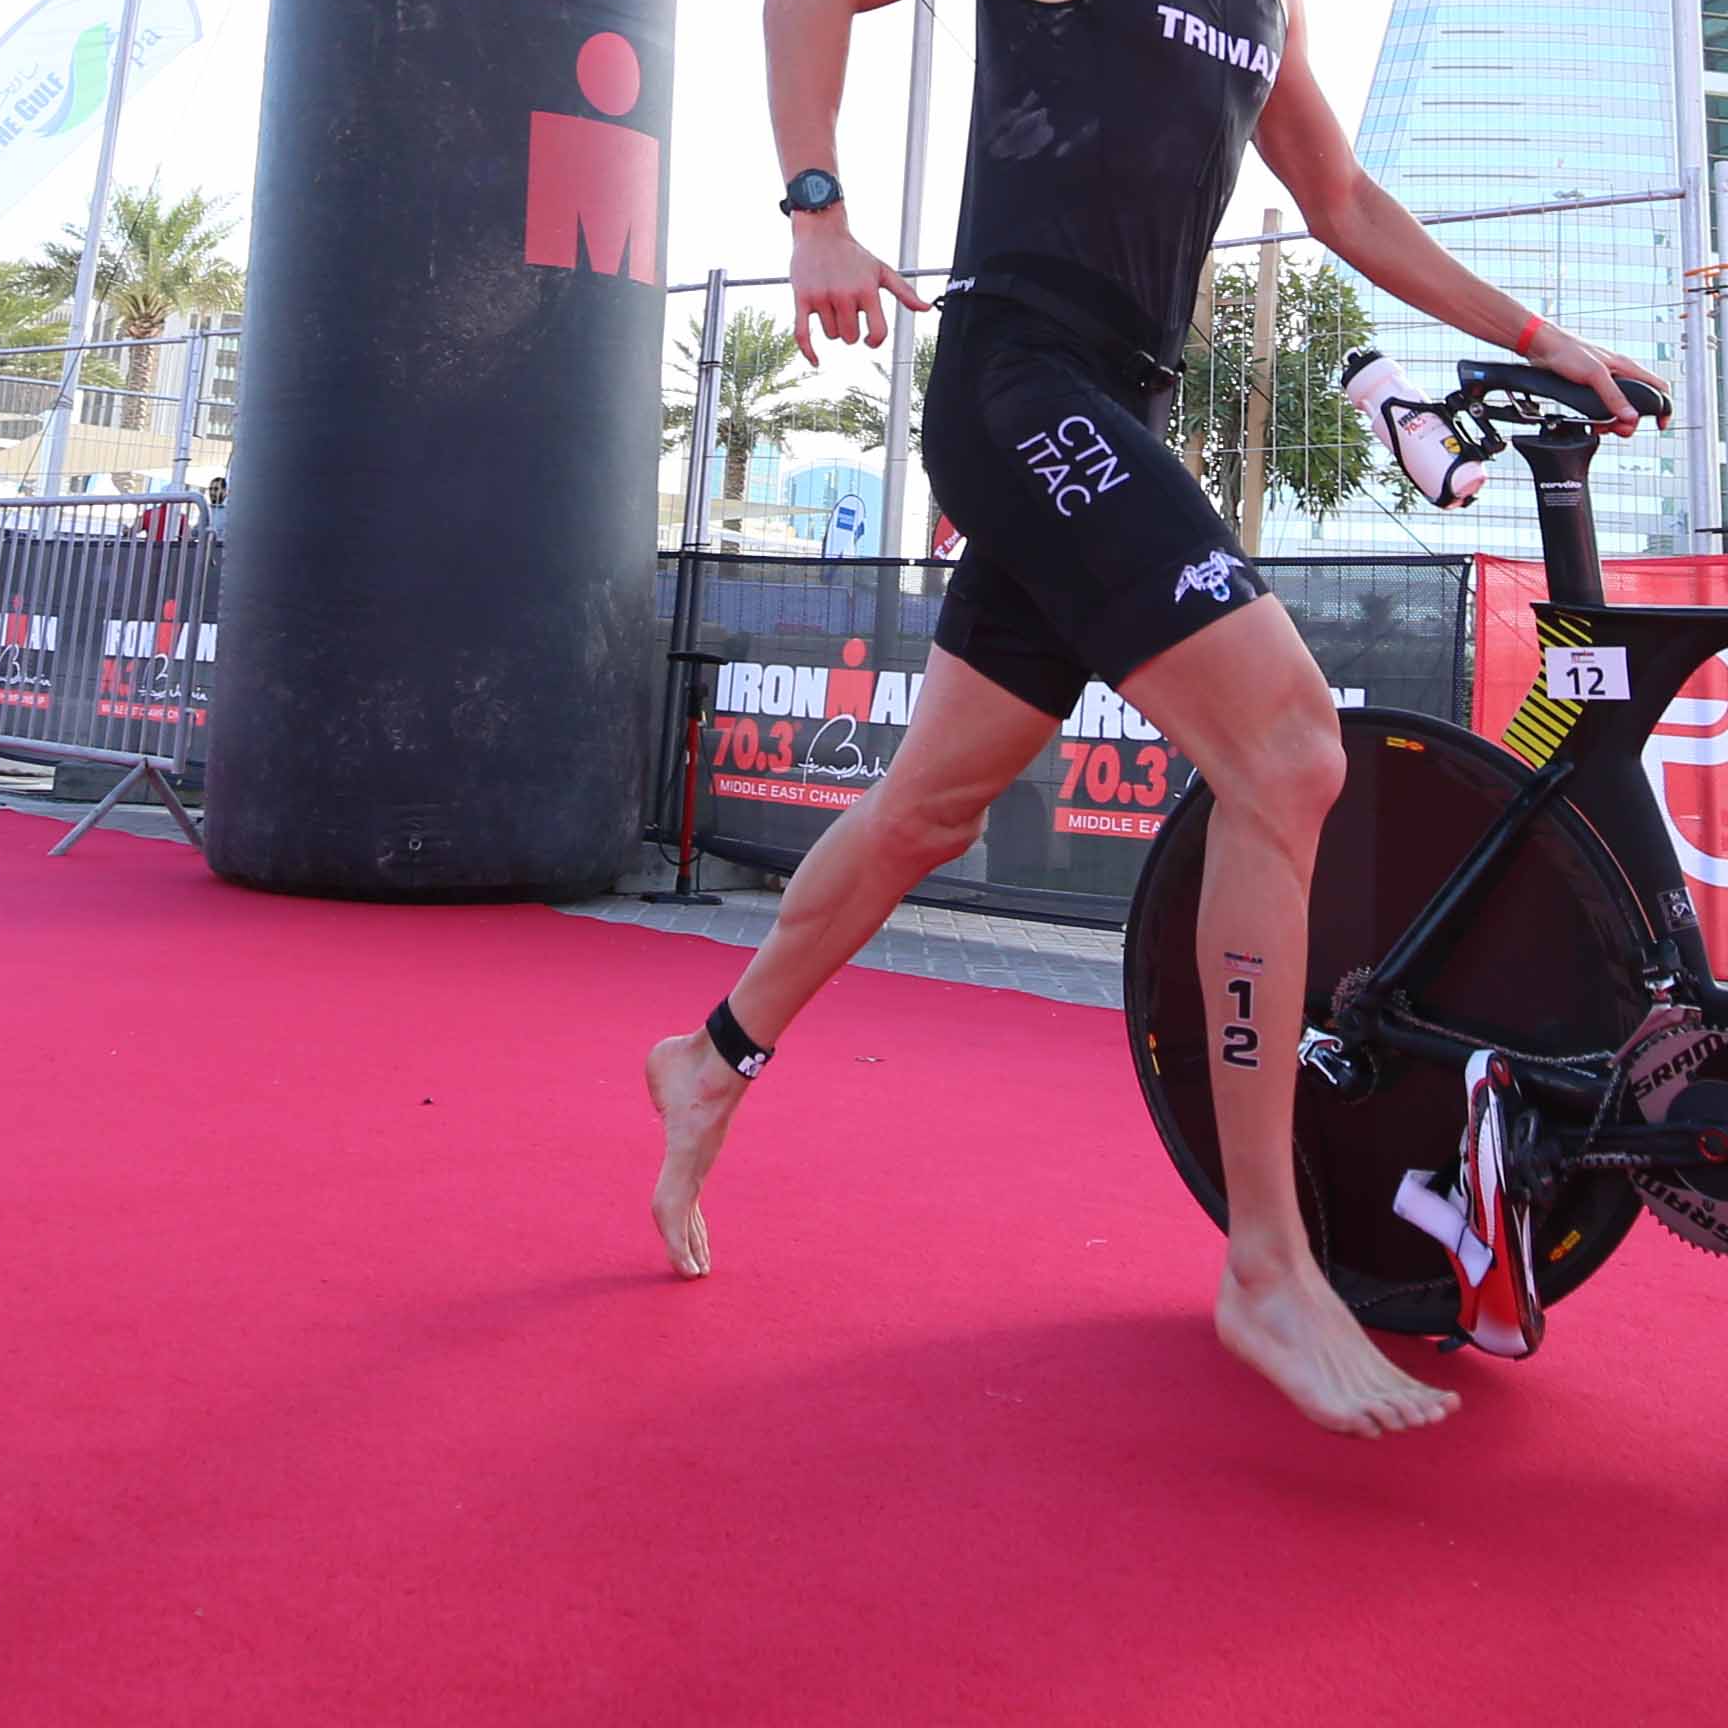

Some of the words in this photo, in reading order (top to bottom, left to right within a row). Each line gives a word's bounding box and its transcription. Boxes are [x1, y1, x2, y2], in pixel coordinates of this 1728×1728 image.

[14, 72, 65, 121] GULF
[1016, 432, 1091, 517] ITAC
[1057, 415, 1131, 493] CTN
[1566, 667, 1606, 696] 12
[713, 715, 795, 774] 70.3
[720, 779, 768, 796] MIDDLE
[770, 785, 806, 801] EAST
[1059, 744, 1169, 808] 70.3
[1068, 814, 1133, 833] MIDDLE
[1139, 819, 1162, 835] EA
[1629, 1032, 1725, 1102] SRAM
